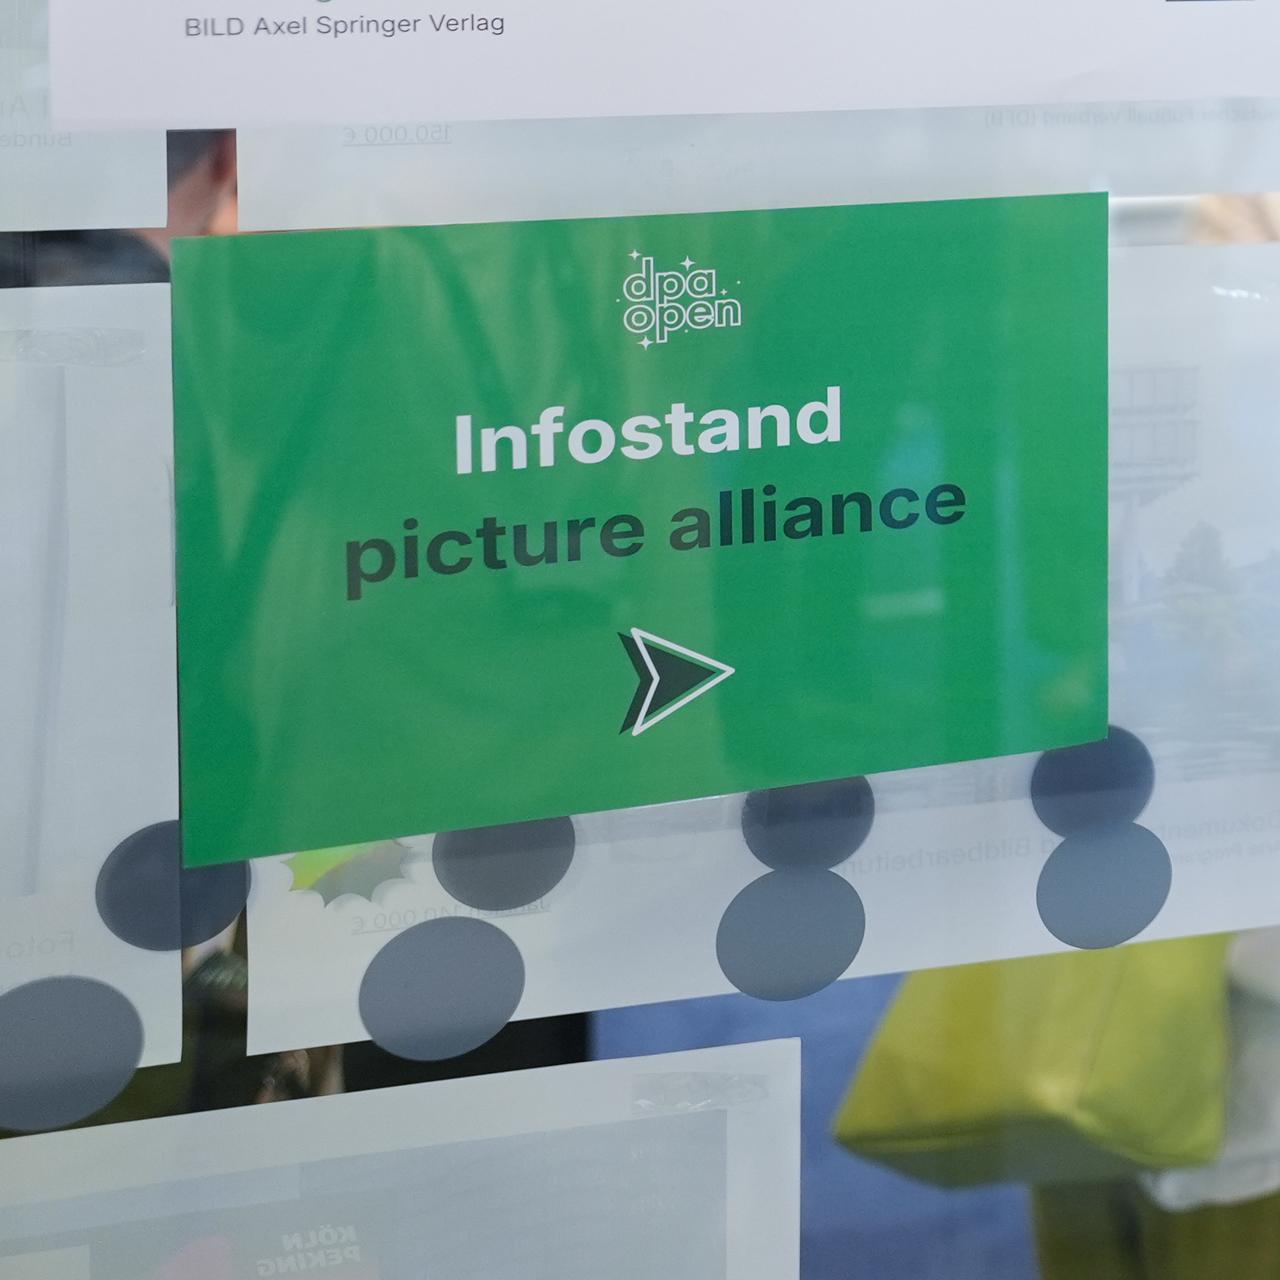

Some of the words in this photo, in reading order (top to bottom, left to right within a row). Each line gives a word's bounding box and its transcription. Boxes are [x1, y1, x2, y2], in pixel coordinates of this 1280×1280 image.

[185, 17, 245, 37] BILD
[253, 16, 307, 36] Axel
[316, 15, 421, 39] Springer
[429, 14, 505, 36] Verlag
[623, 257, 716, 304] dpa
[624, 299, 741, 343] open
[454, 386, 842, 475] Infostand
[346, 514, 645, 601] picture
[669, 482, 967, 552] alliance
